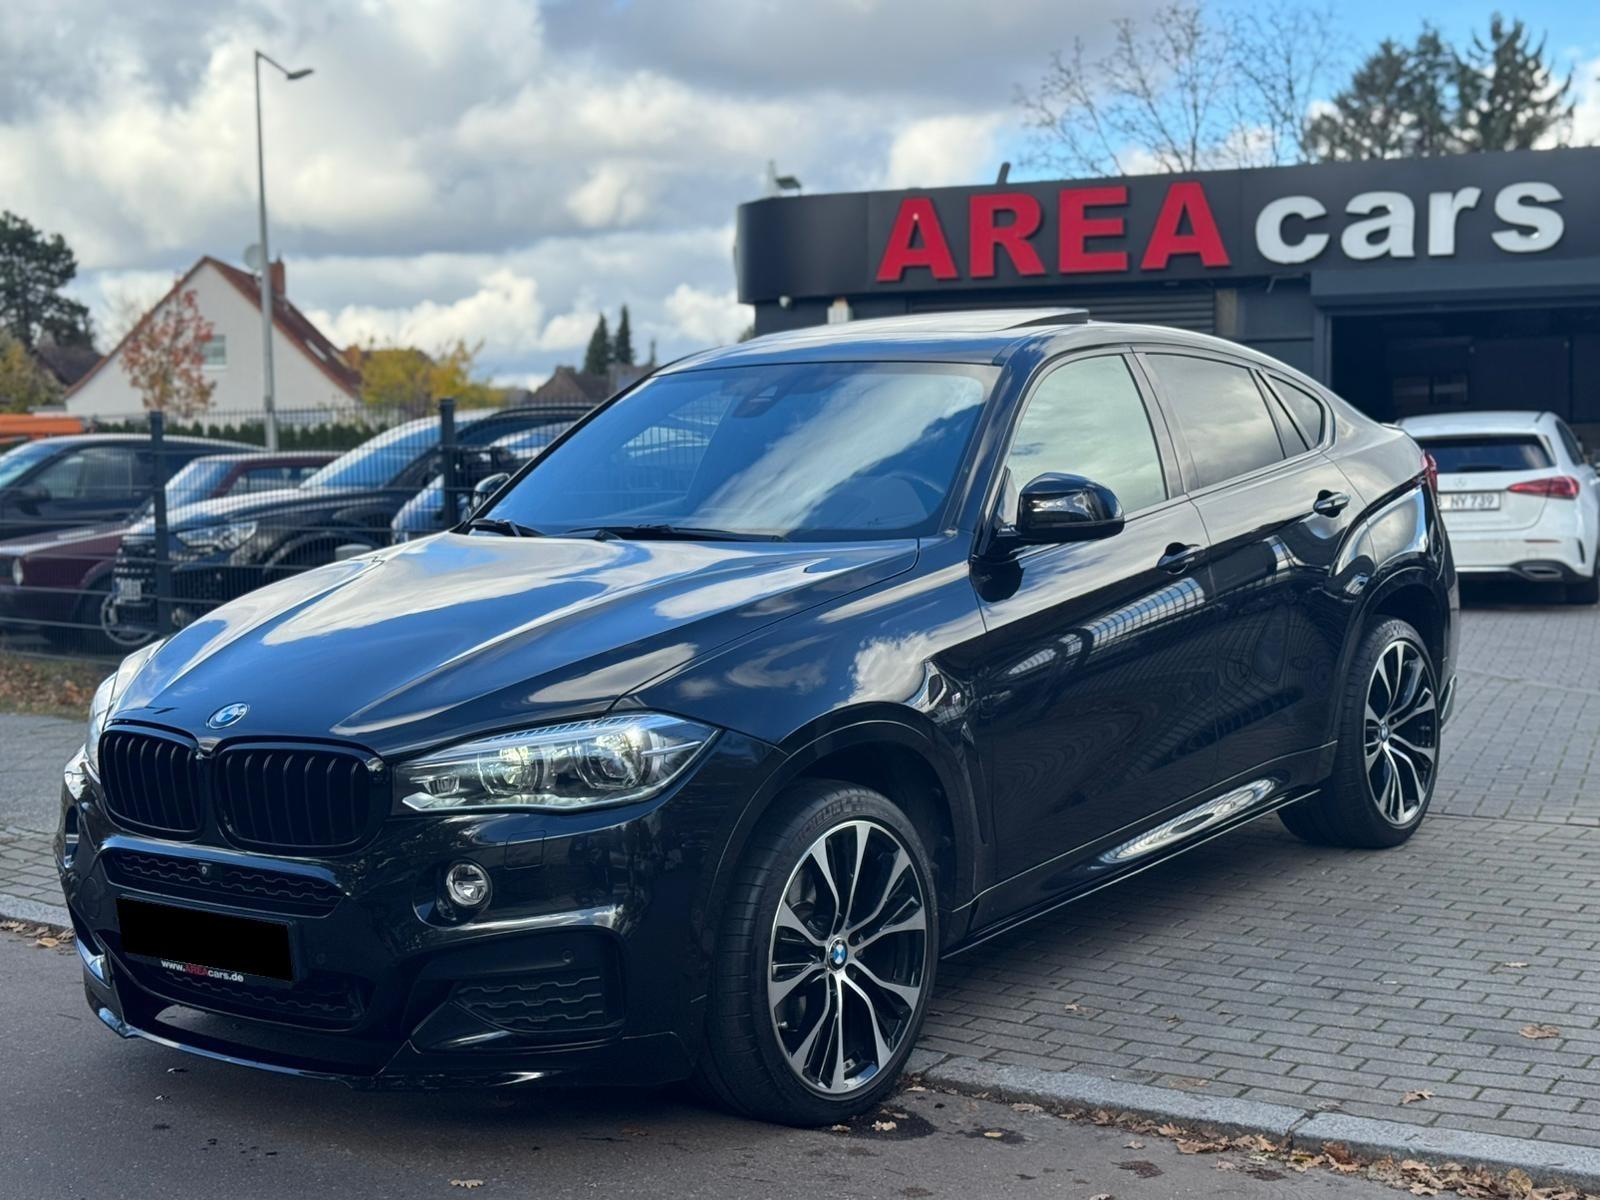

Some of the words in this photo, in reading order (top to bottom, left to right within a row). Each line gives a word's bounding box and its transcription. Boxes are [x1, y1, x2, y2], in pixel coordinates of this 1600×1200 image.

[877, 182, 1230, 282] AREA
[1255, 182, 1565, 264] cars
[160, 959, 244, 982] www.AREAcars.de
